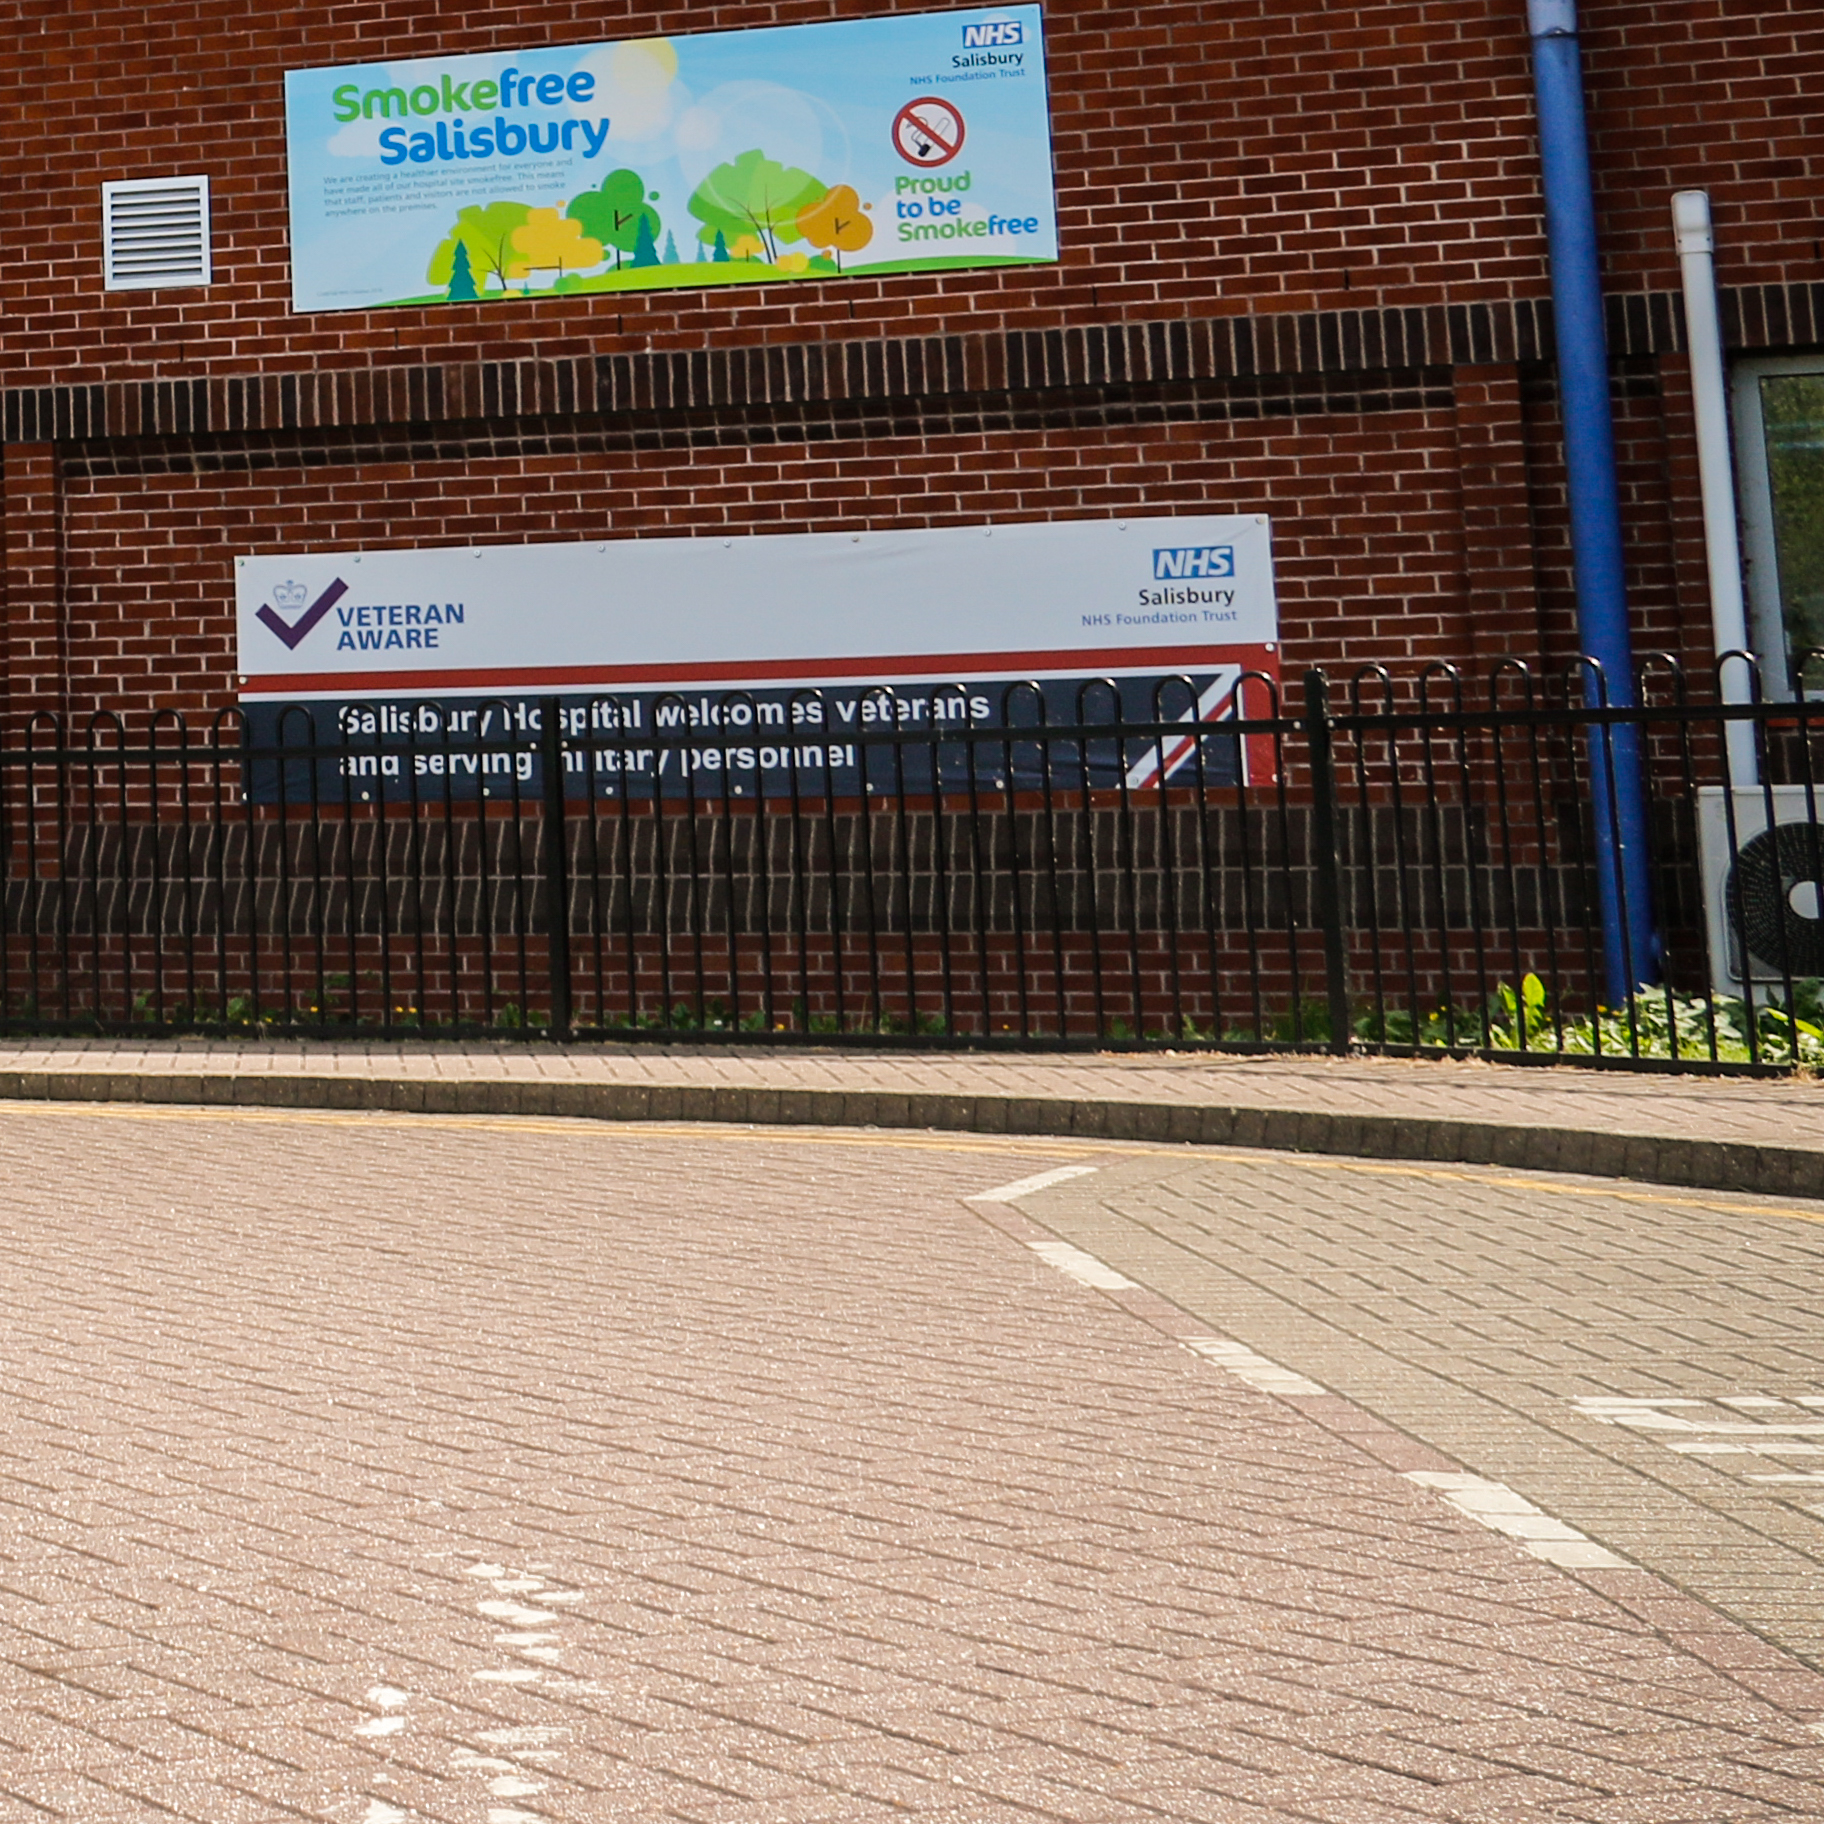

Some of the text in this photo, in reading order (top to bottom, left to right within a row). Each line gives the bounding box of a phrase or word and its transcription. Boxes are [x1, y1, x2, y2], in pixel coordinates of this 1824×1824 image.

[963, 22, 1022, 48] NHS
[952, 51, 1024, 68] Salisbury
[910, 68, 1026, 86] NHS Foundation Trust
[332, 67, 595, 122] Smokefree
[378, 116, 610, 165] Salisbury
[895, 170, 971, 195] Proud
[896, 196, 961, 218] to be
[897, 214, 1039, 242] Smokefree
[1155, 547, 1232, 578] NHS
[1139, 586, 1235, 607] Salisbury
[336, 603, 465, 627] VETERAN
[1082, 609, 1237, 626] NHS Foundation Trust
[336, 629, 439, 651] AWARE
[655, 697, 823, 727] welcomes
[835, 694, 990, 723] veterans
[414, 752, 532, 781] serving
